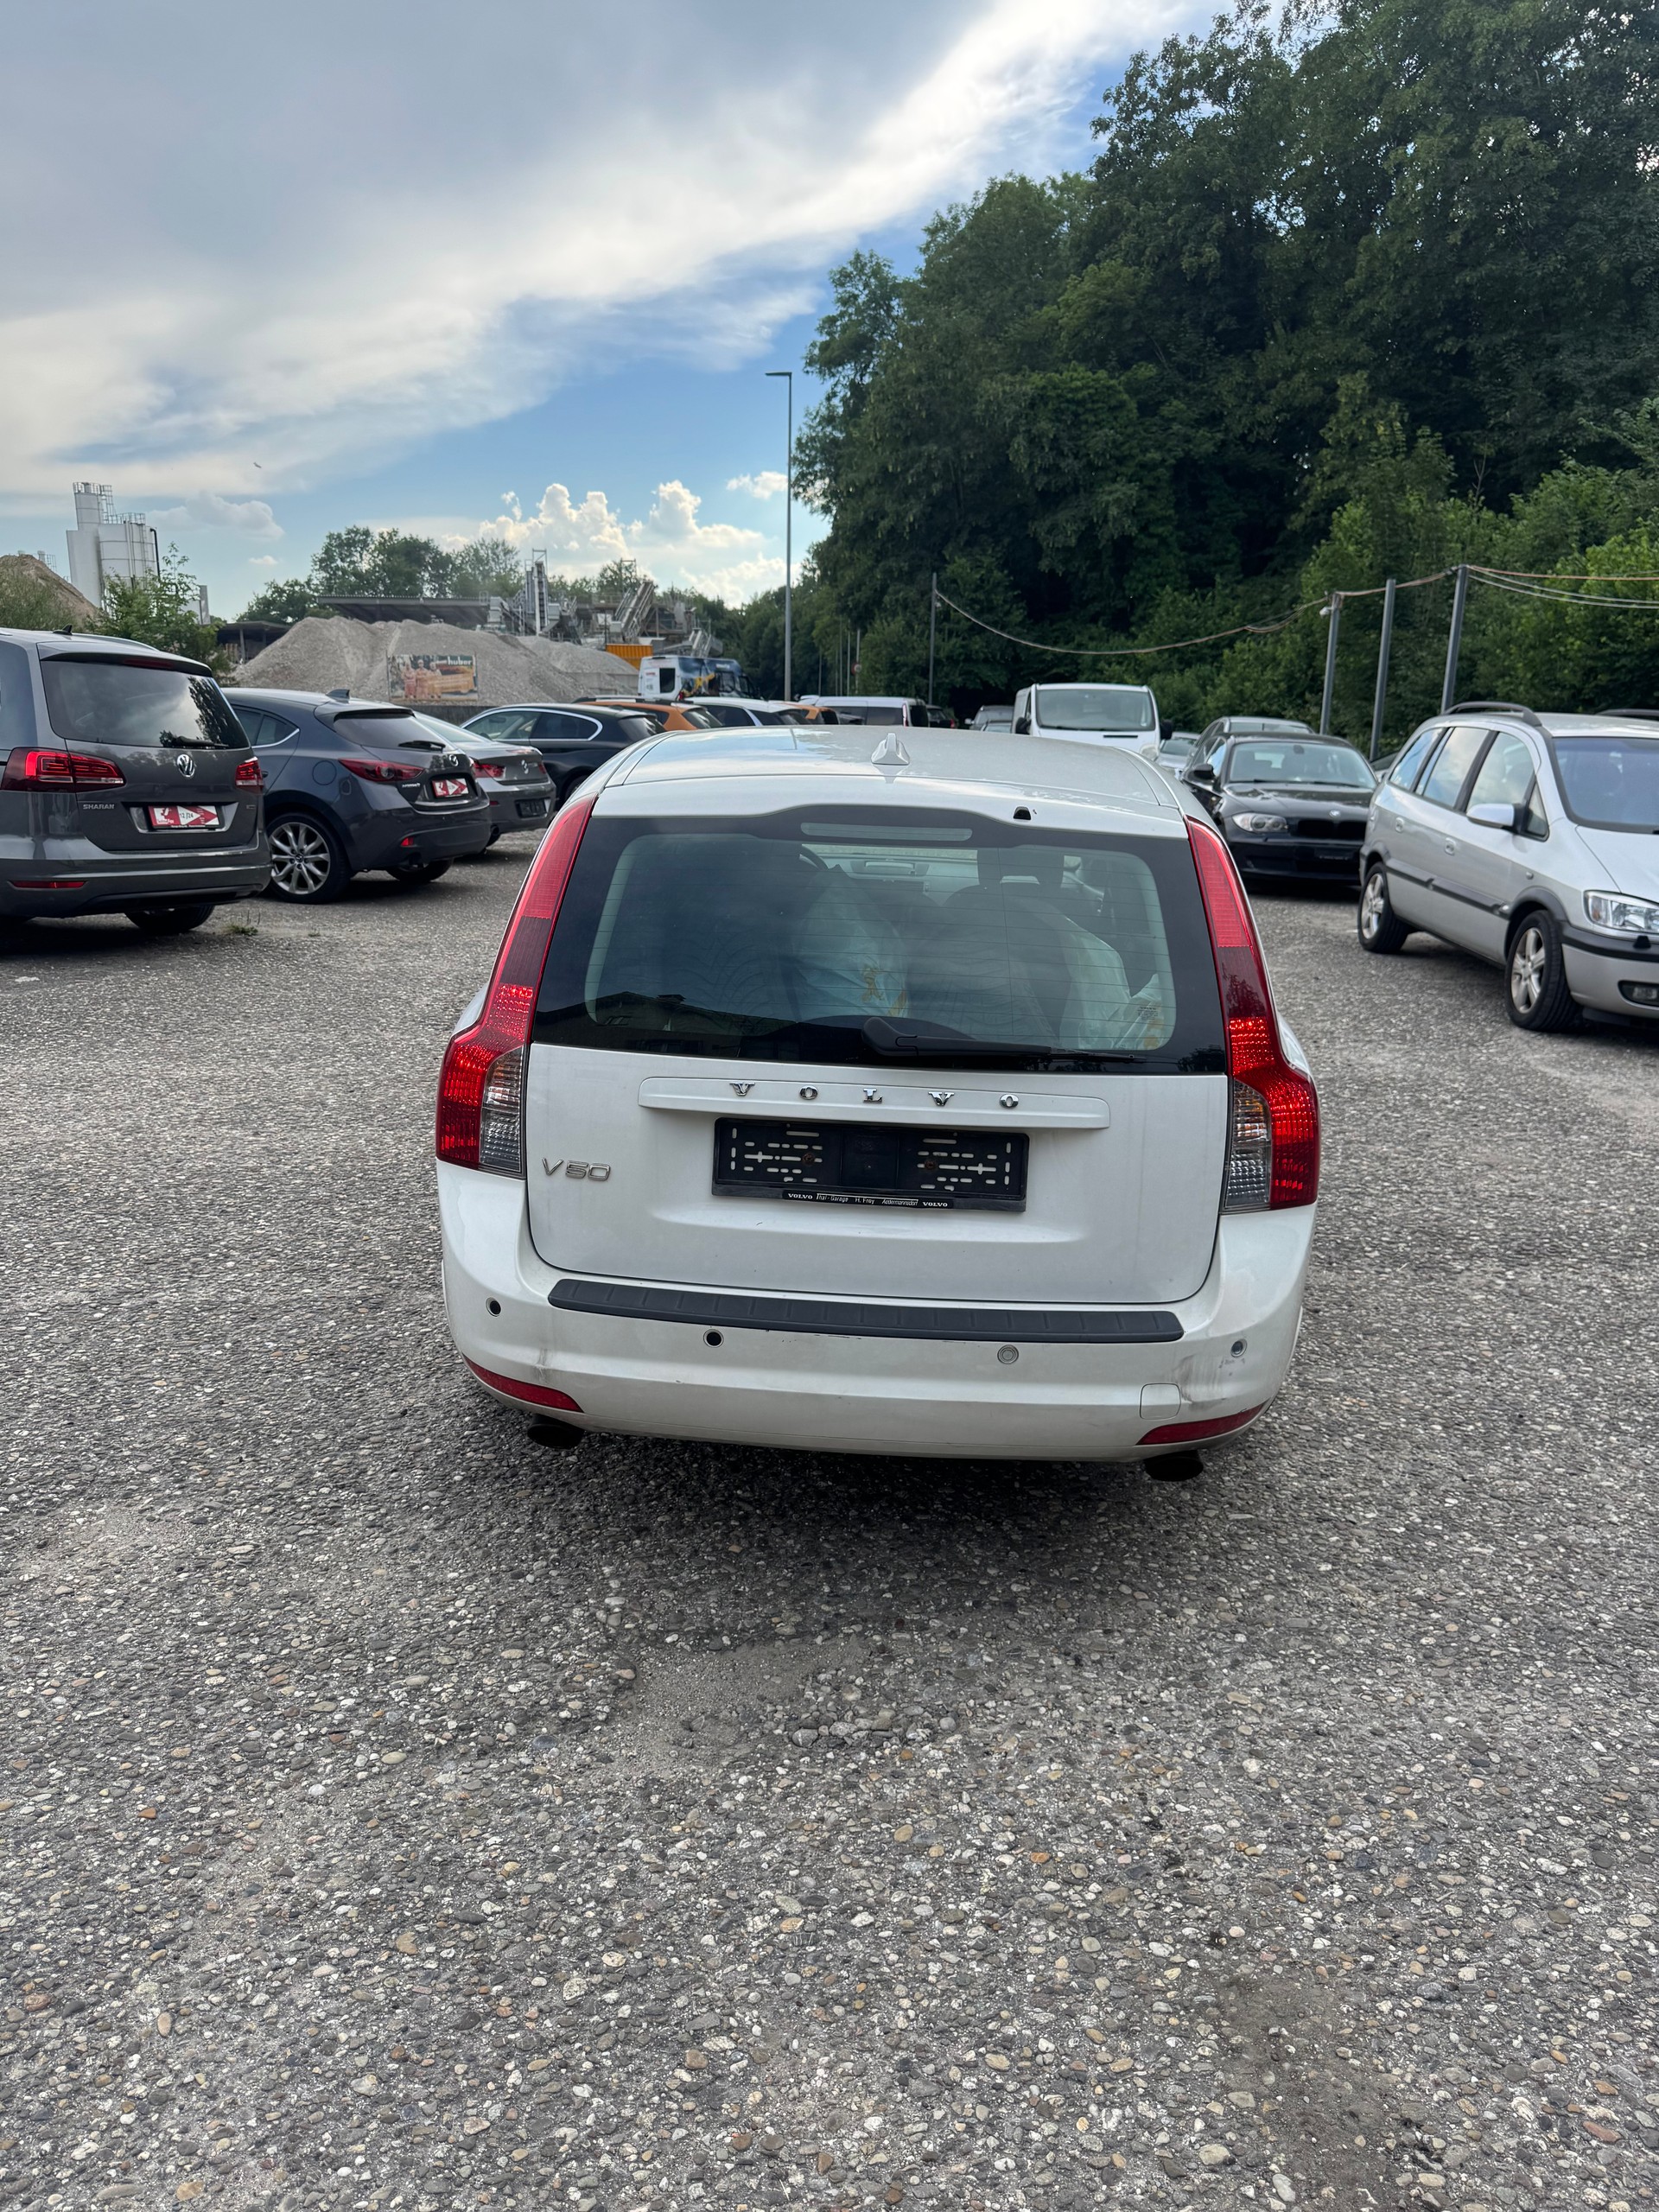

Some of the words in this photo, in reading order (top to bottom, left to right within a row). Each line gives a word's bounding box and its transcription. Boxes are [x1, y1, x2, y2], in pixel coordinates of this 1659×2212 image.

[448, 656, 473, 665] huber
[729, 1082, 1020, 1109] VOLVO
[541, 1157, 611, 1181] V50
